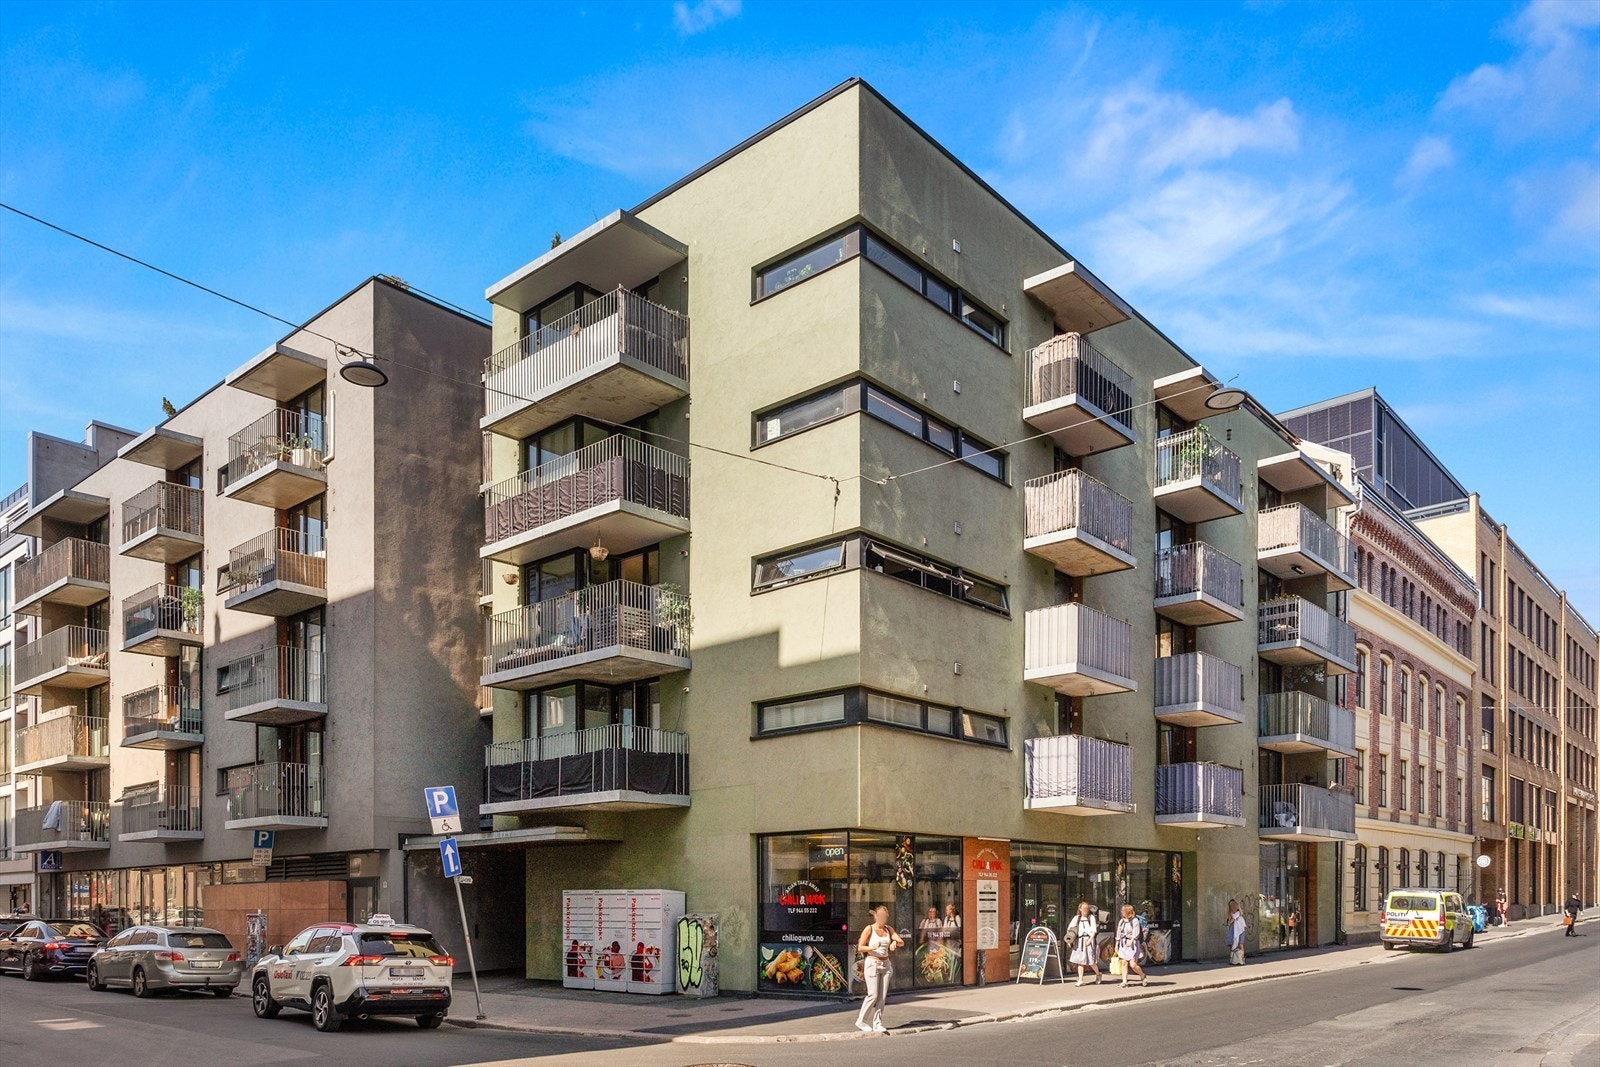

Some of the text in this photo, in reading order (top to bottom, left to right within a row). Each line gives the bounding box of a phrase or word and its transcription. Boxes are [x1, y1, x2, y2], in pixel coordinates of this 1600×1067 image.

[433, 790, 449, 814] P
[258, 831, 269, 846] P
[825, 848, 844, 857] open
[986, 861, 990, 869] &
[785, 882, 797, 893] ASIAN
[808, 882, 820, 892] AWAY
[780, 894, 826, 905] CHILI & WOK
[782, 934, 824, 943] chiliogwok.no
